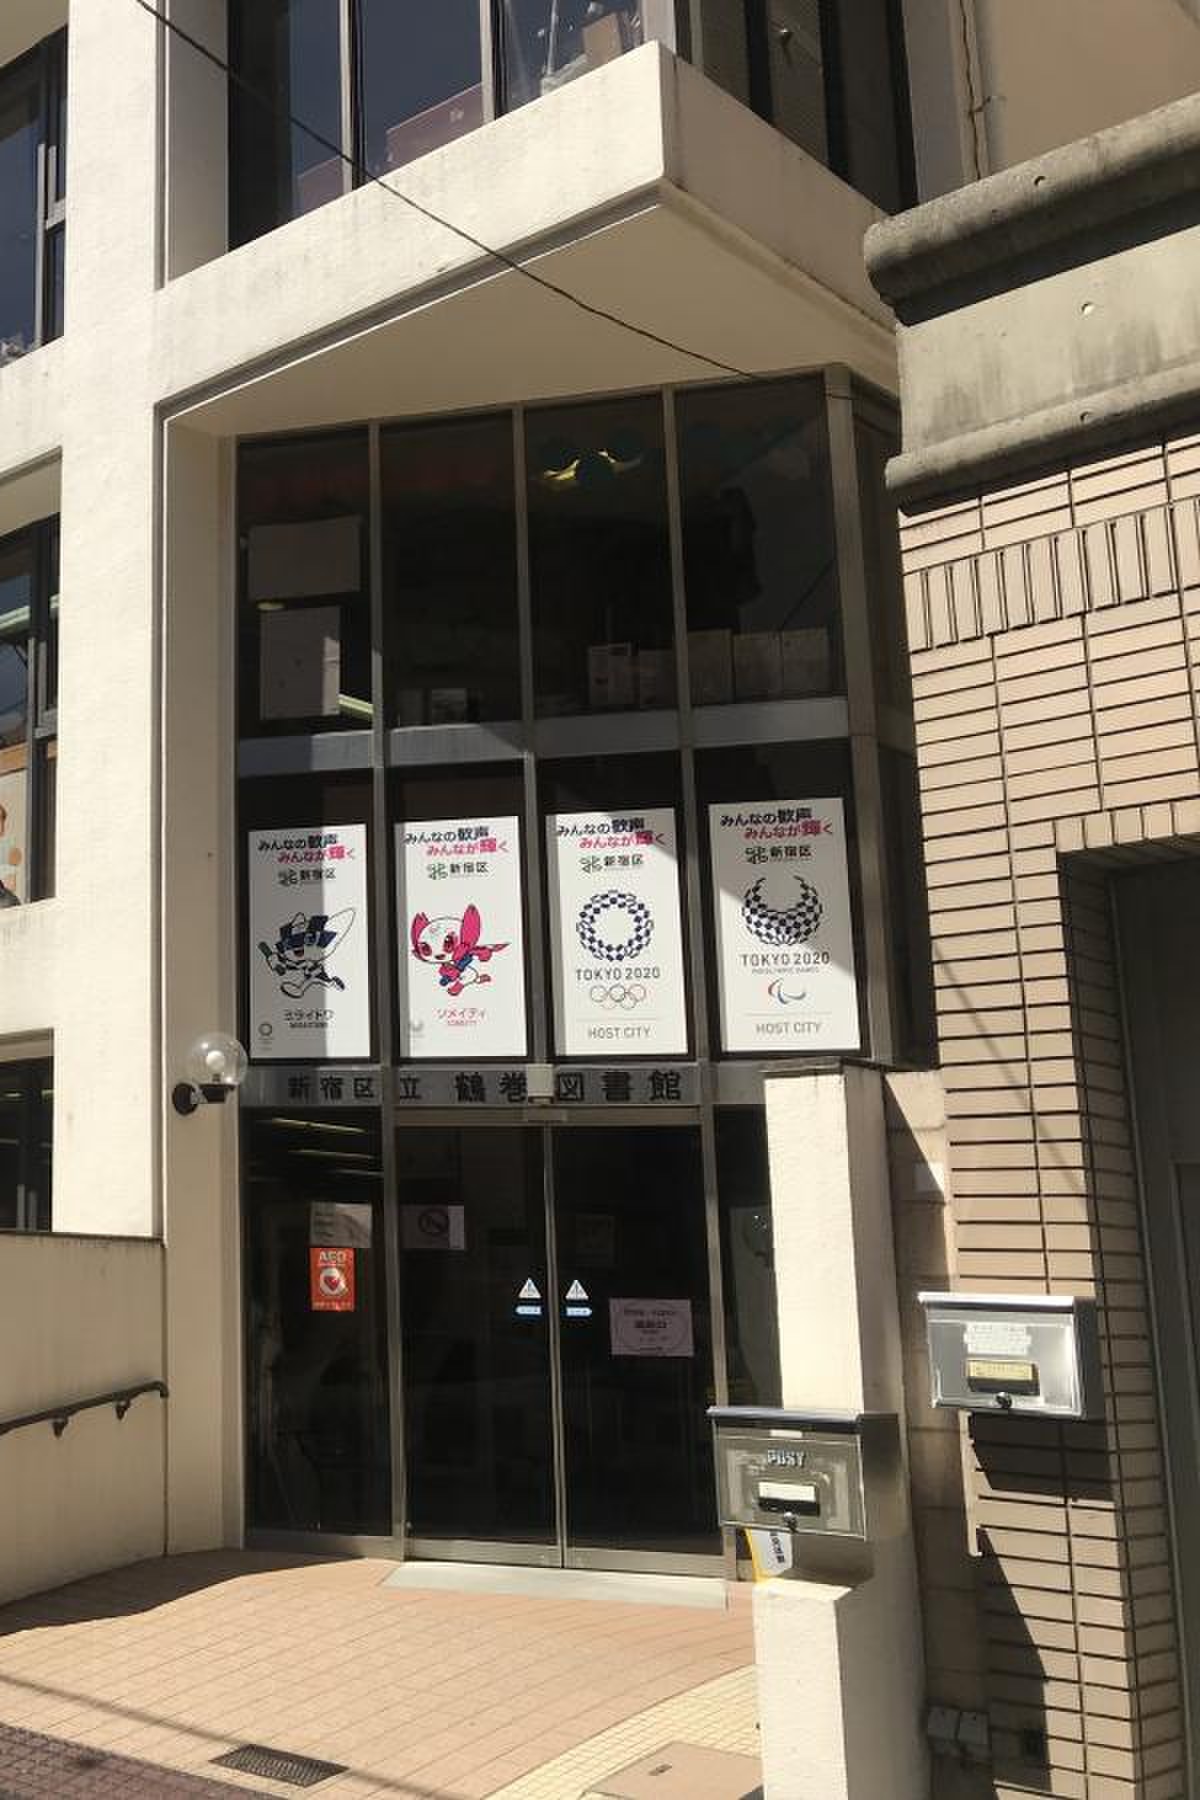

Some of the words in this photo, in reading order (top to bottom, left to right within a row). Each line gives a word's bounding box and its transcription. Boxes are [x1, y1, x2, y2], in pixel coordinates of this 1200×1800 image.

[739, 953, 790, 967] TOKYO
[793, 951, 831, 965] 2020
[575, 967, 622, 981] TOKYO
[625, 966, 661, 980] 2020
[588, 1027, 621, 1040] HOST
[623, 1026, 651, 1038] CITY
[756, 1023, 789, 1034] HOST
[793, 1022, 822, 1033] CITY
[288, 1074, 422, 1101] 新宿区立
[767, 1449, 805, 1467] POST
